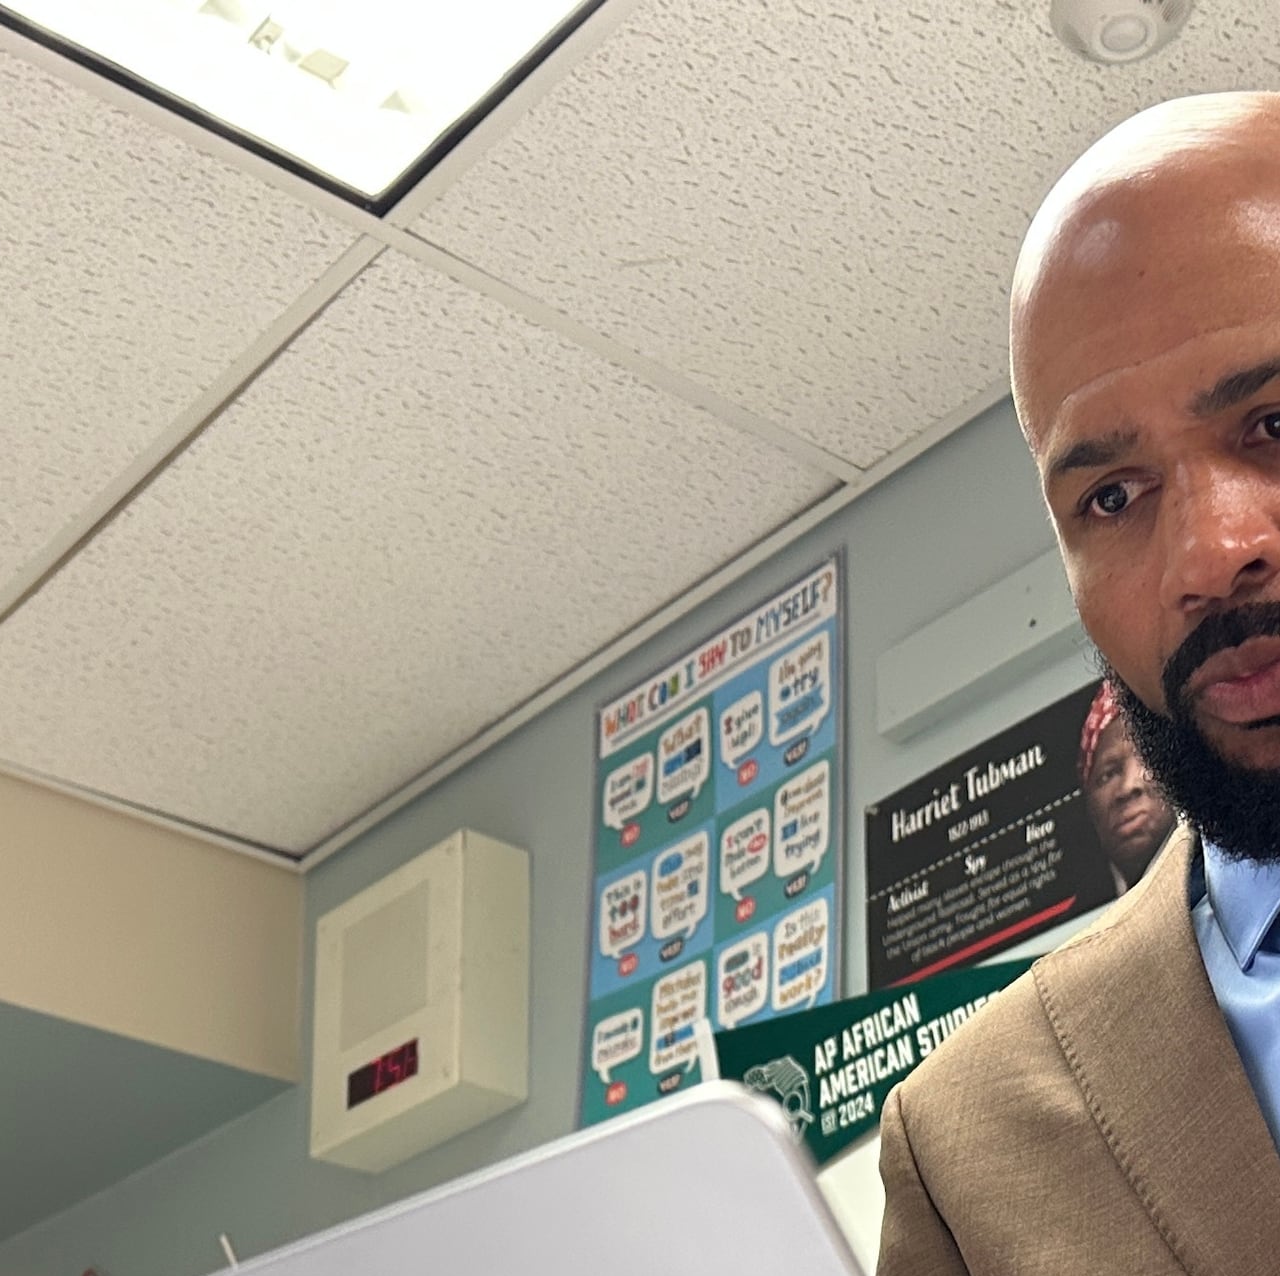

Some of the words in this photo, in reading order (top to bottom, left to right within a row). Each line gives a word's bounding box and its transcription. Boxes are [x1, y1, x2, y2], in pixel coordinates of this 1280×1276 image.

[729, 627, 752, 657] TO
[756, 570, 833, 644] MYSELF?
[891, 781, 961, 843] Harriet
[964, 744, 1046, 803] Tubman
[887, 881, 929, 912] Activist
[1025, 819, 1055, 845] Hero
[815, 1038, 837, 1075] AP
[841, 991, 920, 1061] AFRICAN
[820, 1035, 914, 1109] AMERICAN
[838, 1092, 875, 1127] 2024
